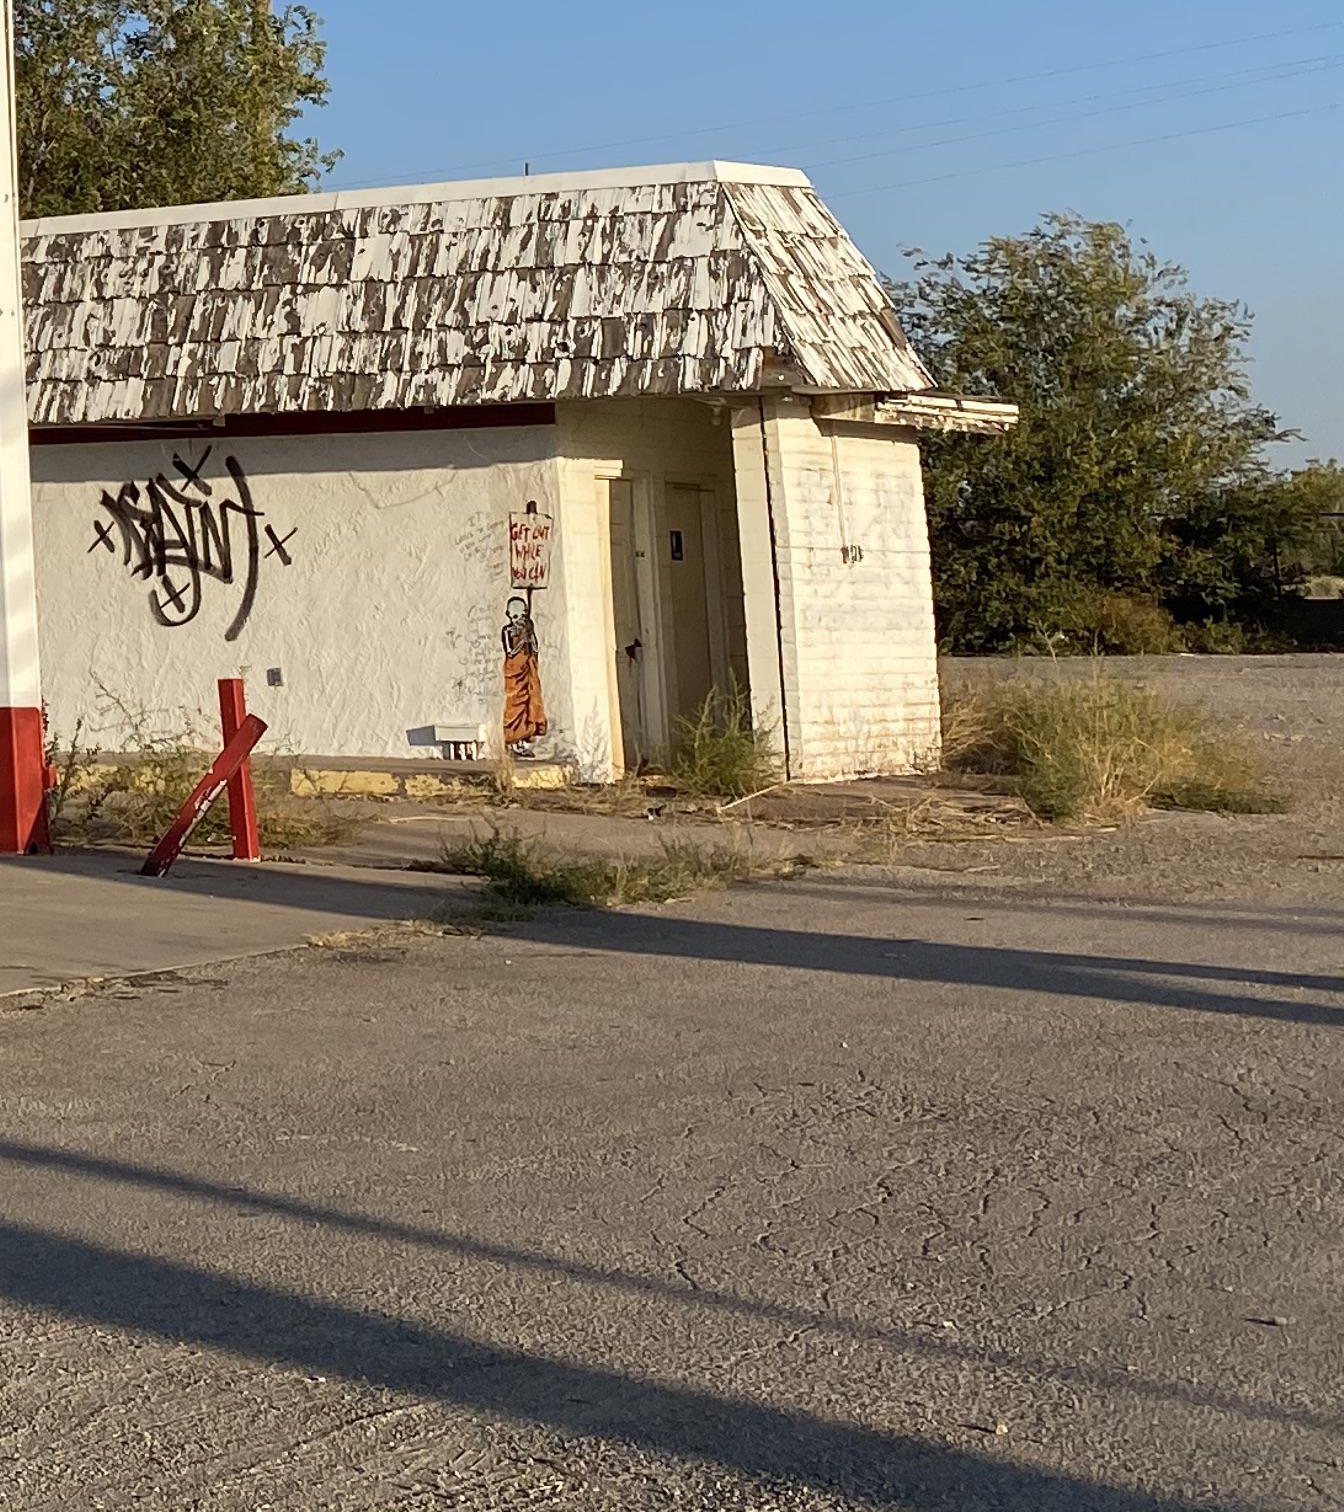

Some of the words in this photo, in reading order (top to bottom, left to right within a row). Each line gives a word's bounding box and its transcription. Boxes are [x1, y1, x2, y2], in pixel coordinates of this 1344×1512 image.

[511, 522, 530, 543] GET
[532, 524, 550, 541] OUT
[528, 561, 547, 584] CAN
